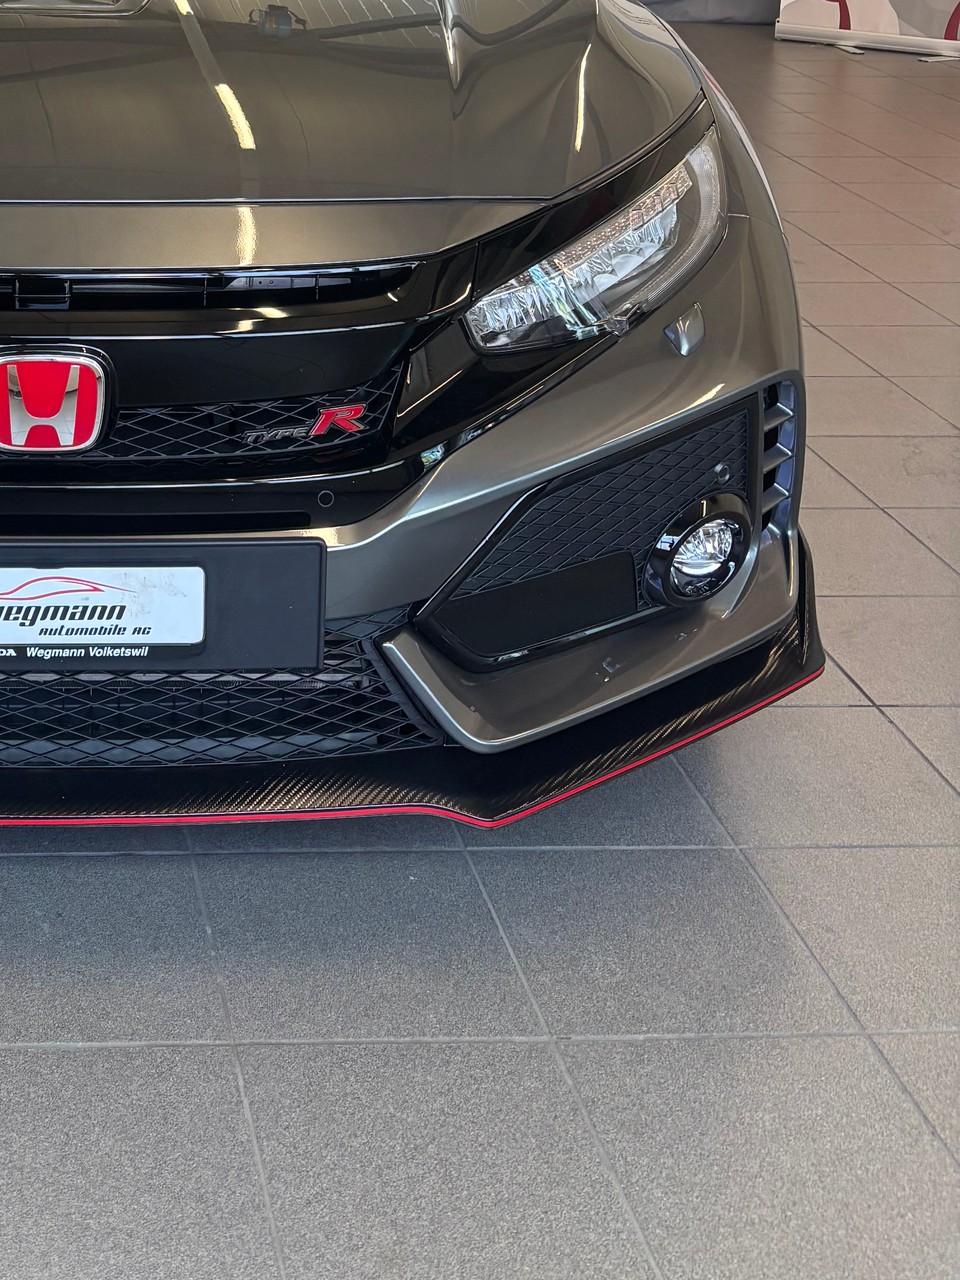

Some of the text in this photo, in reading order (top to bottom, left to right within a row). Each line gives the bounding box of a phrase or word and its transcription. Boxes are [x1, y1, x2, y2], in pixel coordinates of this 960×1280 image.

[242, 403, 369, 444] TYPE R
[26, 646, 85, 659] Wegmann
[88, 646, 149, 658] Volketswil
